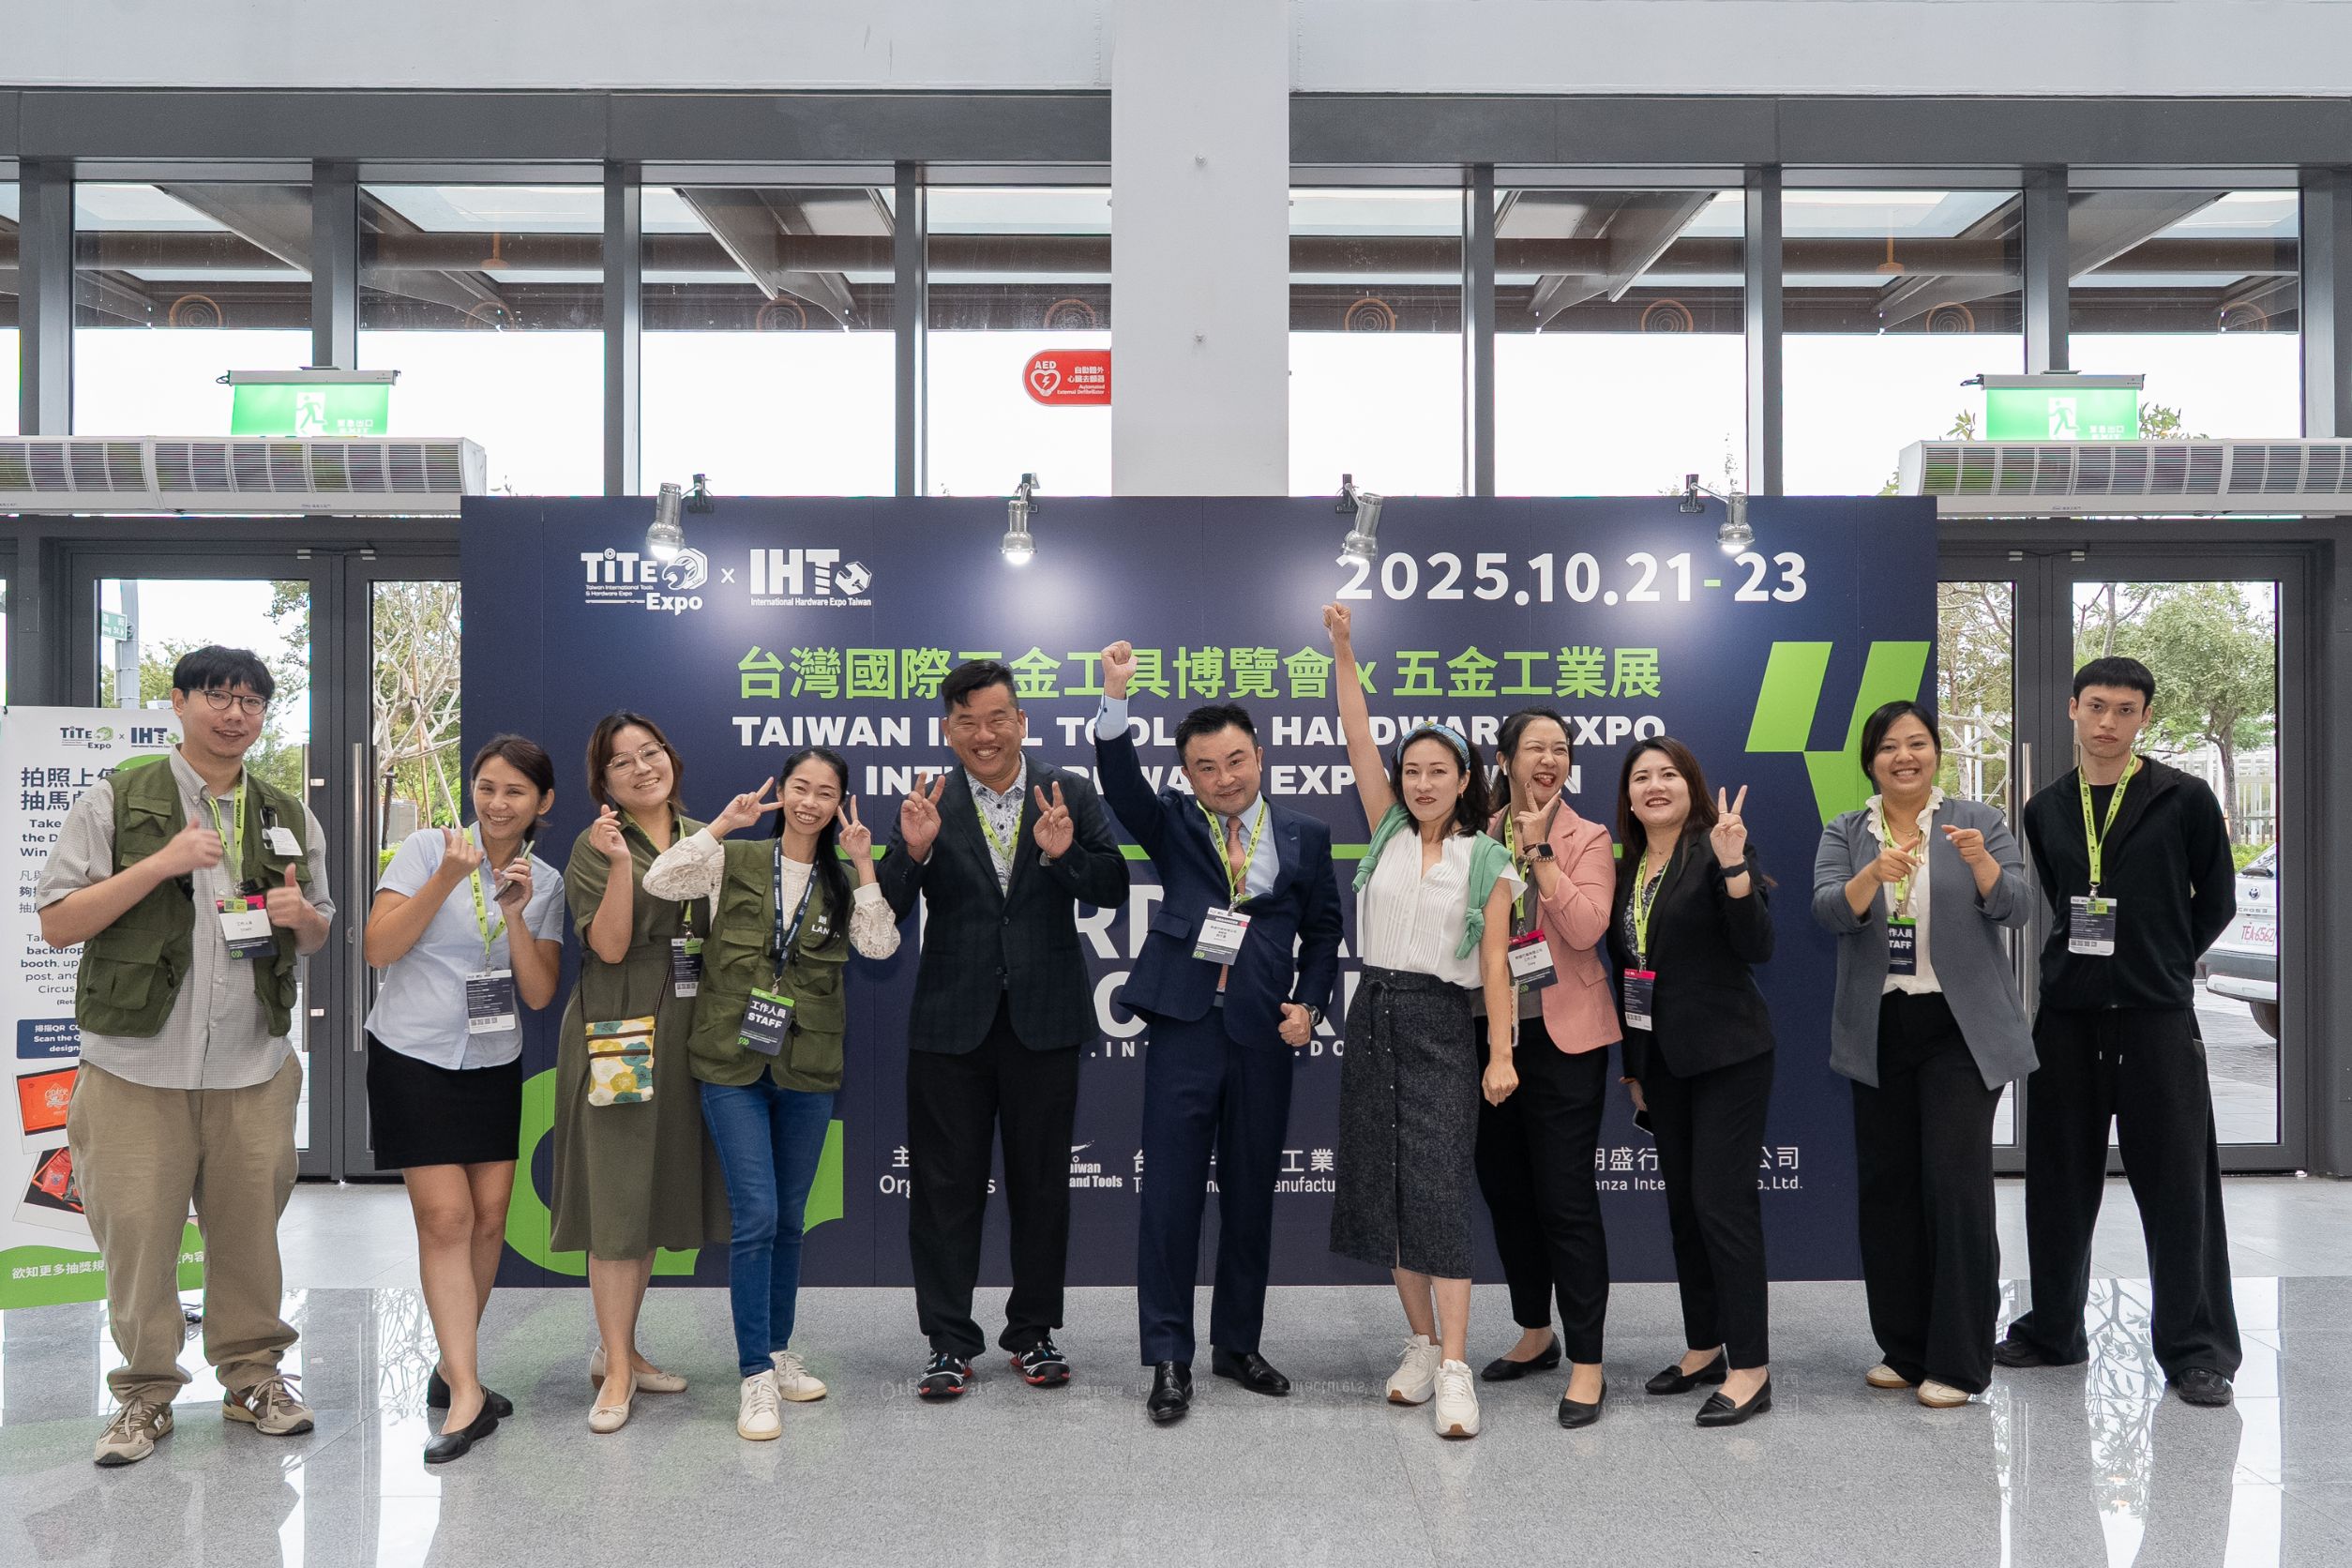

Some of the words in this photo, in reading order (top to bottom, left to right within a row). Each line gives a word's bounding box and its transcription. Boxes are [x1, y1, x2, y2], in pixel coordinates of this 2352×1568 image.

[1034, 361, 1057, 369] AED
[749, 549, 839, 595] IHT
[646, 592, 703, 616] Expo
[750, 597, 793, 606] International
[795, 597, 828, 606] Hardware
[830, 597, 847, 608] Expo
[848, 597, 871, 606] Taiwan
[737, 644, 1334, 700] 台灣國際金工具博覽會
[1393, 645, 1662, 699] 五金工業展
[731, 716, 911, 746] TAIWAN
[1567, 716, 1666, 746] XPO
[87, 742, 112, 750] Expo
[1271, 765, 1390, 795] EXP
[21, 790, 83, 811] 抽馬
[29, 819, 62, 828] Take
[23, 833, 45, 842] the
[21, 848, 47, 857] Win
[19, 886, 37, 897] 夠
[19, 902, 37, 913] 抽
[1889, 927, 1913, 939] 作人員
[26, 945, 84, 956] backdrop
[1889, 940, 1912, 950] TAFF
[21, 958, 60, 968] booth,
[25, 972, 54, 982] post,
[38, 985, 75, 994] Circus
[749, 1000, 787, 1019] 工作人員
[747, 1012, 783, 1029] STAFF
[49, 1044, 81, 1053] design
[1069, 1163, 1101, 1173] iwan
[1069, 1175, 1091, 1187] and
[1092, 1175, 1123, 1187] Tools
[1274, 1176, 1335, 1193] anufactu
